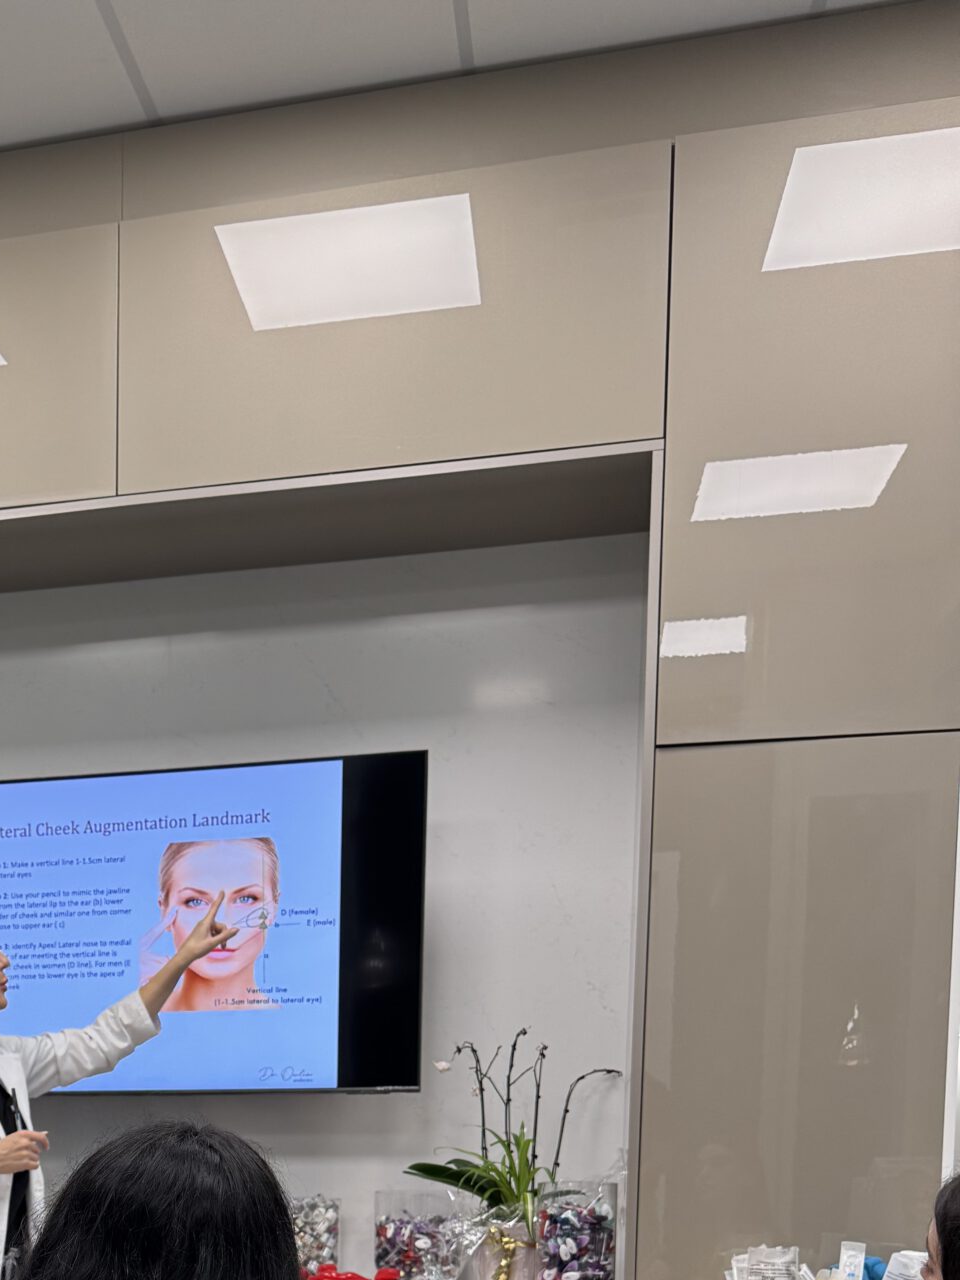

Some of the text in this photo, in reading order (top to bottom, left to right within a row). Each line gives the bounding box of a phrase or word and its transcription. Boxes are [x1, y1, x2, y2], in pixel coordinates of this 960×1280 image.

[36, 820, 79, 837] Cheek
[83, 815, 187, 837] Augmentation
[191, 810, 271, 828] Landmark
[11, 860, 28, 869] Make
[36, 858, 60, 867] vertical
[62, 858, 74, 866] line
[76, 856, 102, 865] 1-1.5cm
[104, 855, 125, 863] lateral
[17, 871, 32, 880] eyes
[11, 892, 23, 900] Use
[25, 892, 39, 901] your
[41, 889, 60, 900] pencil
[63, 889, 70, 897] to
[72, 888, 92, 897] mimic
[94, 888, 104, 896] the
[106, 886, 130, 897] jawline
[15, 901, 25, 909] the
[27, 900, 48, 908] lateral
[59, 899, 66, 907] to
[68, 898, 78, 907] the
[104, 896, 123, 905] lower
[10, 911, 17, 919] of
[19, 910, 38, 919] cheek
[41, 910, 52, 918] and
[54, 909, 76, 917] similar
[92, 907, 108, 916] from
[281, 907, 319, 919] D (female)
[21, 921, 40, 931] upper
[42, 921, 53, 929] ear
[313, 918, 336, 929] (male)
[100, 938, 107, 946] to
[109, 937, 132, 946] medial
[31, 952, 58, 961] meeting
[60, 951, 70, 959] the
[72, 950, 96, 958] vertical
[98, 949, 111, 957] line
[112, 949, 118, 957] is
[13, 962, 32, 970] cheek
[34, 962, 40, 970] in
[95, 959, 106, 968] For
[38, 972, 45, 980] to
[47, 971, 66, 979] lower
[67, 971, 78, 981] eye
[80, 970, 86, 978] is
[87, 969, 98, 978] the
[100, 970, 115, 979] apex
[117, 968, 125, 977] of
[246, 986, 273, 994] Vertical
[246, 996, 269, 1005] lateral
[271, 997, 279, 1005] to
[280, 995, 303, 1004] lateral
